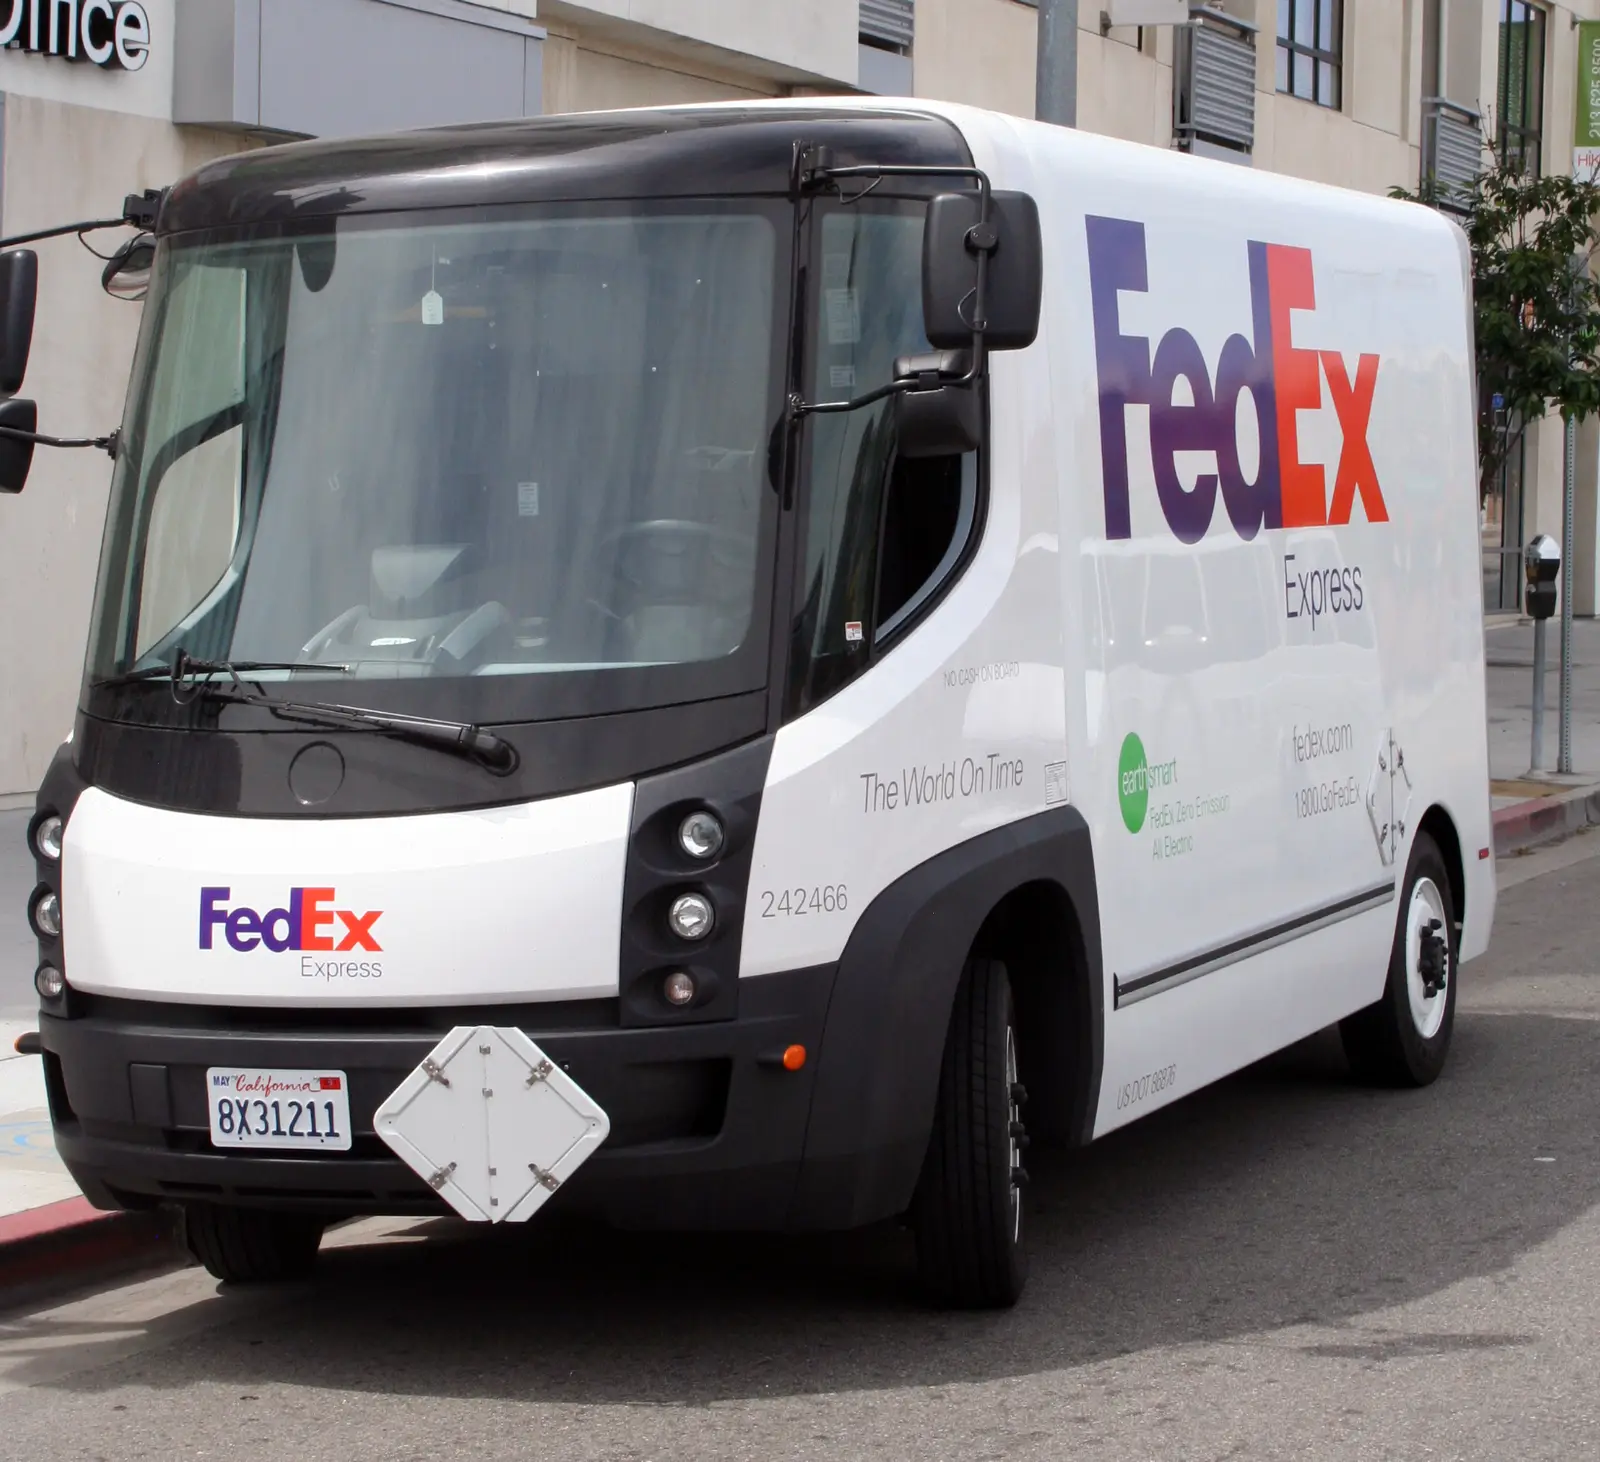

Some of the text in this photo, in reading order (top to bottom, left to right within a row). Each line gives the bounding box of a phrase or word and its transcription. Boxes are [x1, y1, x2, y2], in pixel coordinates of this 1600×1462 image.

[1085, 214, 1390, 545] FedEx
[1284, 554, 1363, 631] Express
[944, 661, 1020, 691] NO CASH ON BOARD
[1293, 723, 1354, 764] fedex.com
[860, 772, 899, 813] The
[902, 761, 957, 806] World
[960, 757, 984, 797] On
[987, 752, 1024, 791] Time
[1150, 794, 1230, 830] FedEx Zero Emission
[1152, 835, 1194, 862] All Electric
[761, 884, 849, 918] 242466
[199, 887, 384, 953] FedEx
[301, 956, 382, 982] Express
[213, 1075, 230, 1087] MAY
[235, 1074, 321, 1097] California
[218, 1098, 340, 1137] 8X31211
